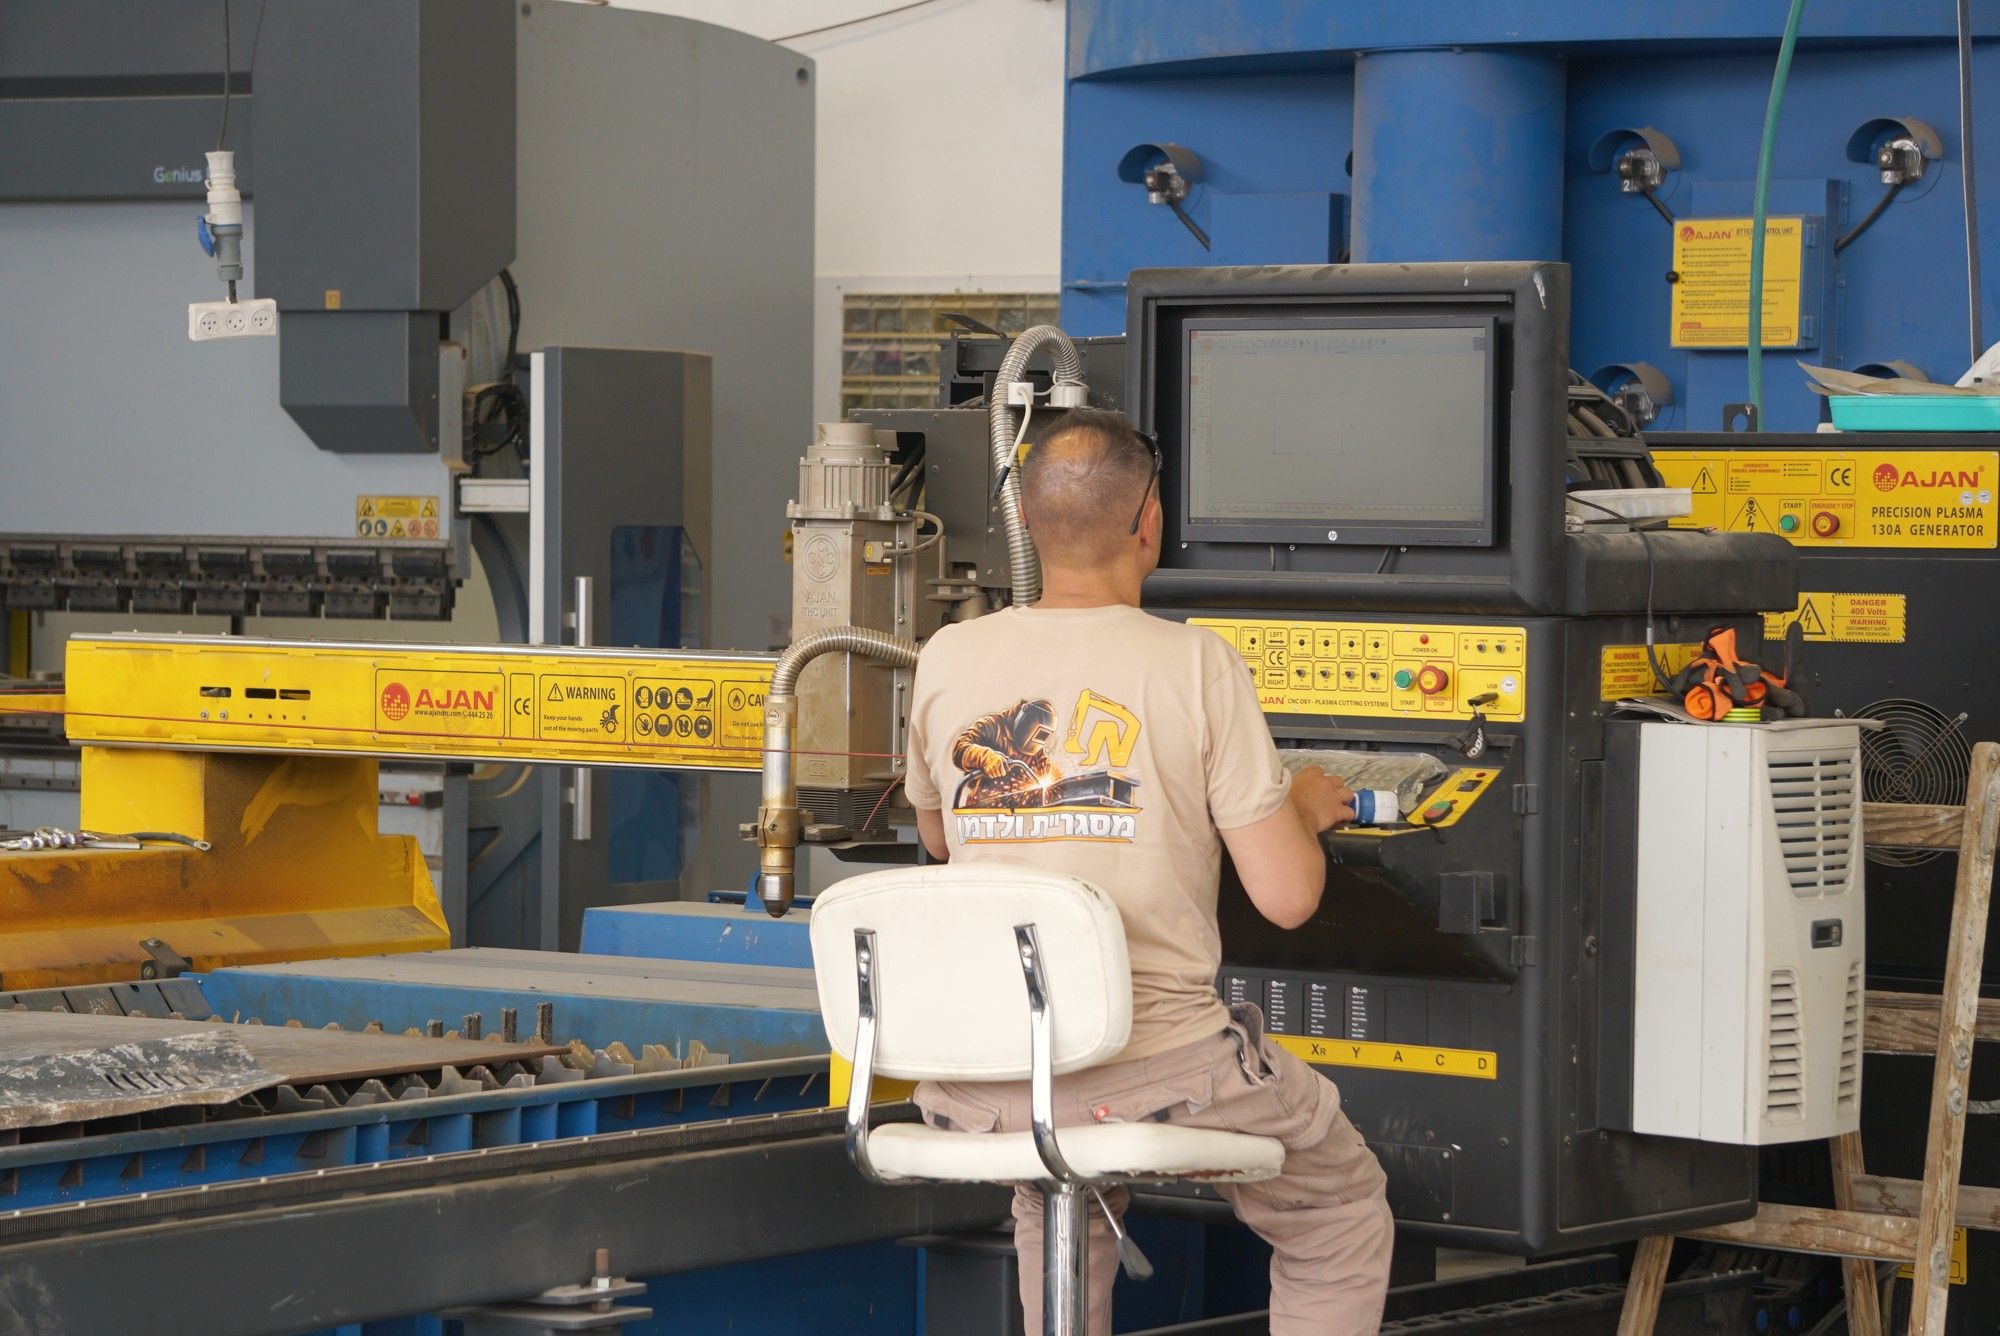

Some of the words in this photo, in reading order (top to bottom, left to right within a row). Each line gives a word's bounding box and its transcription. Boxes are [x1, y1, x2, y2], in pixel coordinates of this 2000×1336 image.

[153, 166, 203, 183] Genius
[1695, 230, 1731, 240] AJAN
[1900, 471, 1979, 488] AJAN
[1871, 507, 1931, 518] PRECISION
[1936, 507, 1984, 519] PLASMA
[1871, 524, 1902, 535] 130A
[1910, 525, 1984, 536] GENERATOR
[806, 591, 836, 604] AJAN
[803, 607, 819, 617] THC
[821, 607, 838, 618] UNIT
[566, 686, 616, 700] WARNING
[415, 688, 494, 711] AJAN
[1260, 696, 1285, 705] JAN
[955, 813, 1025, 846] ולדמן
[1352, 1046, 1361, 1058] Y
[1393, 1051, 1403, 1063] A
[1435, 1054, 1445, 1066] C
[1478, 1057, 1487, 1070] D
